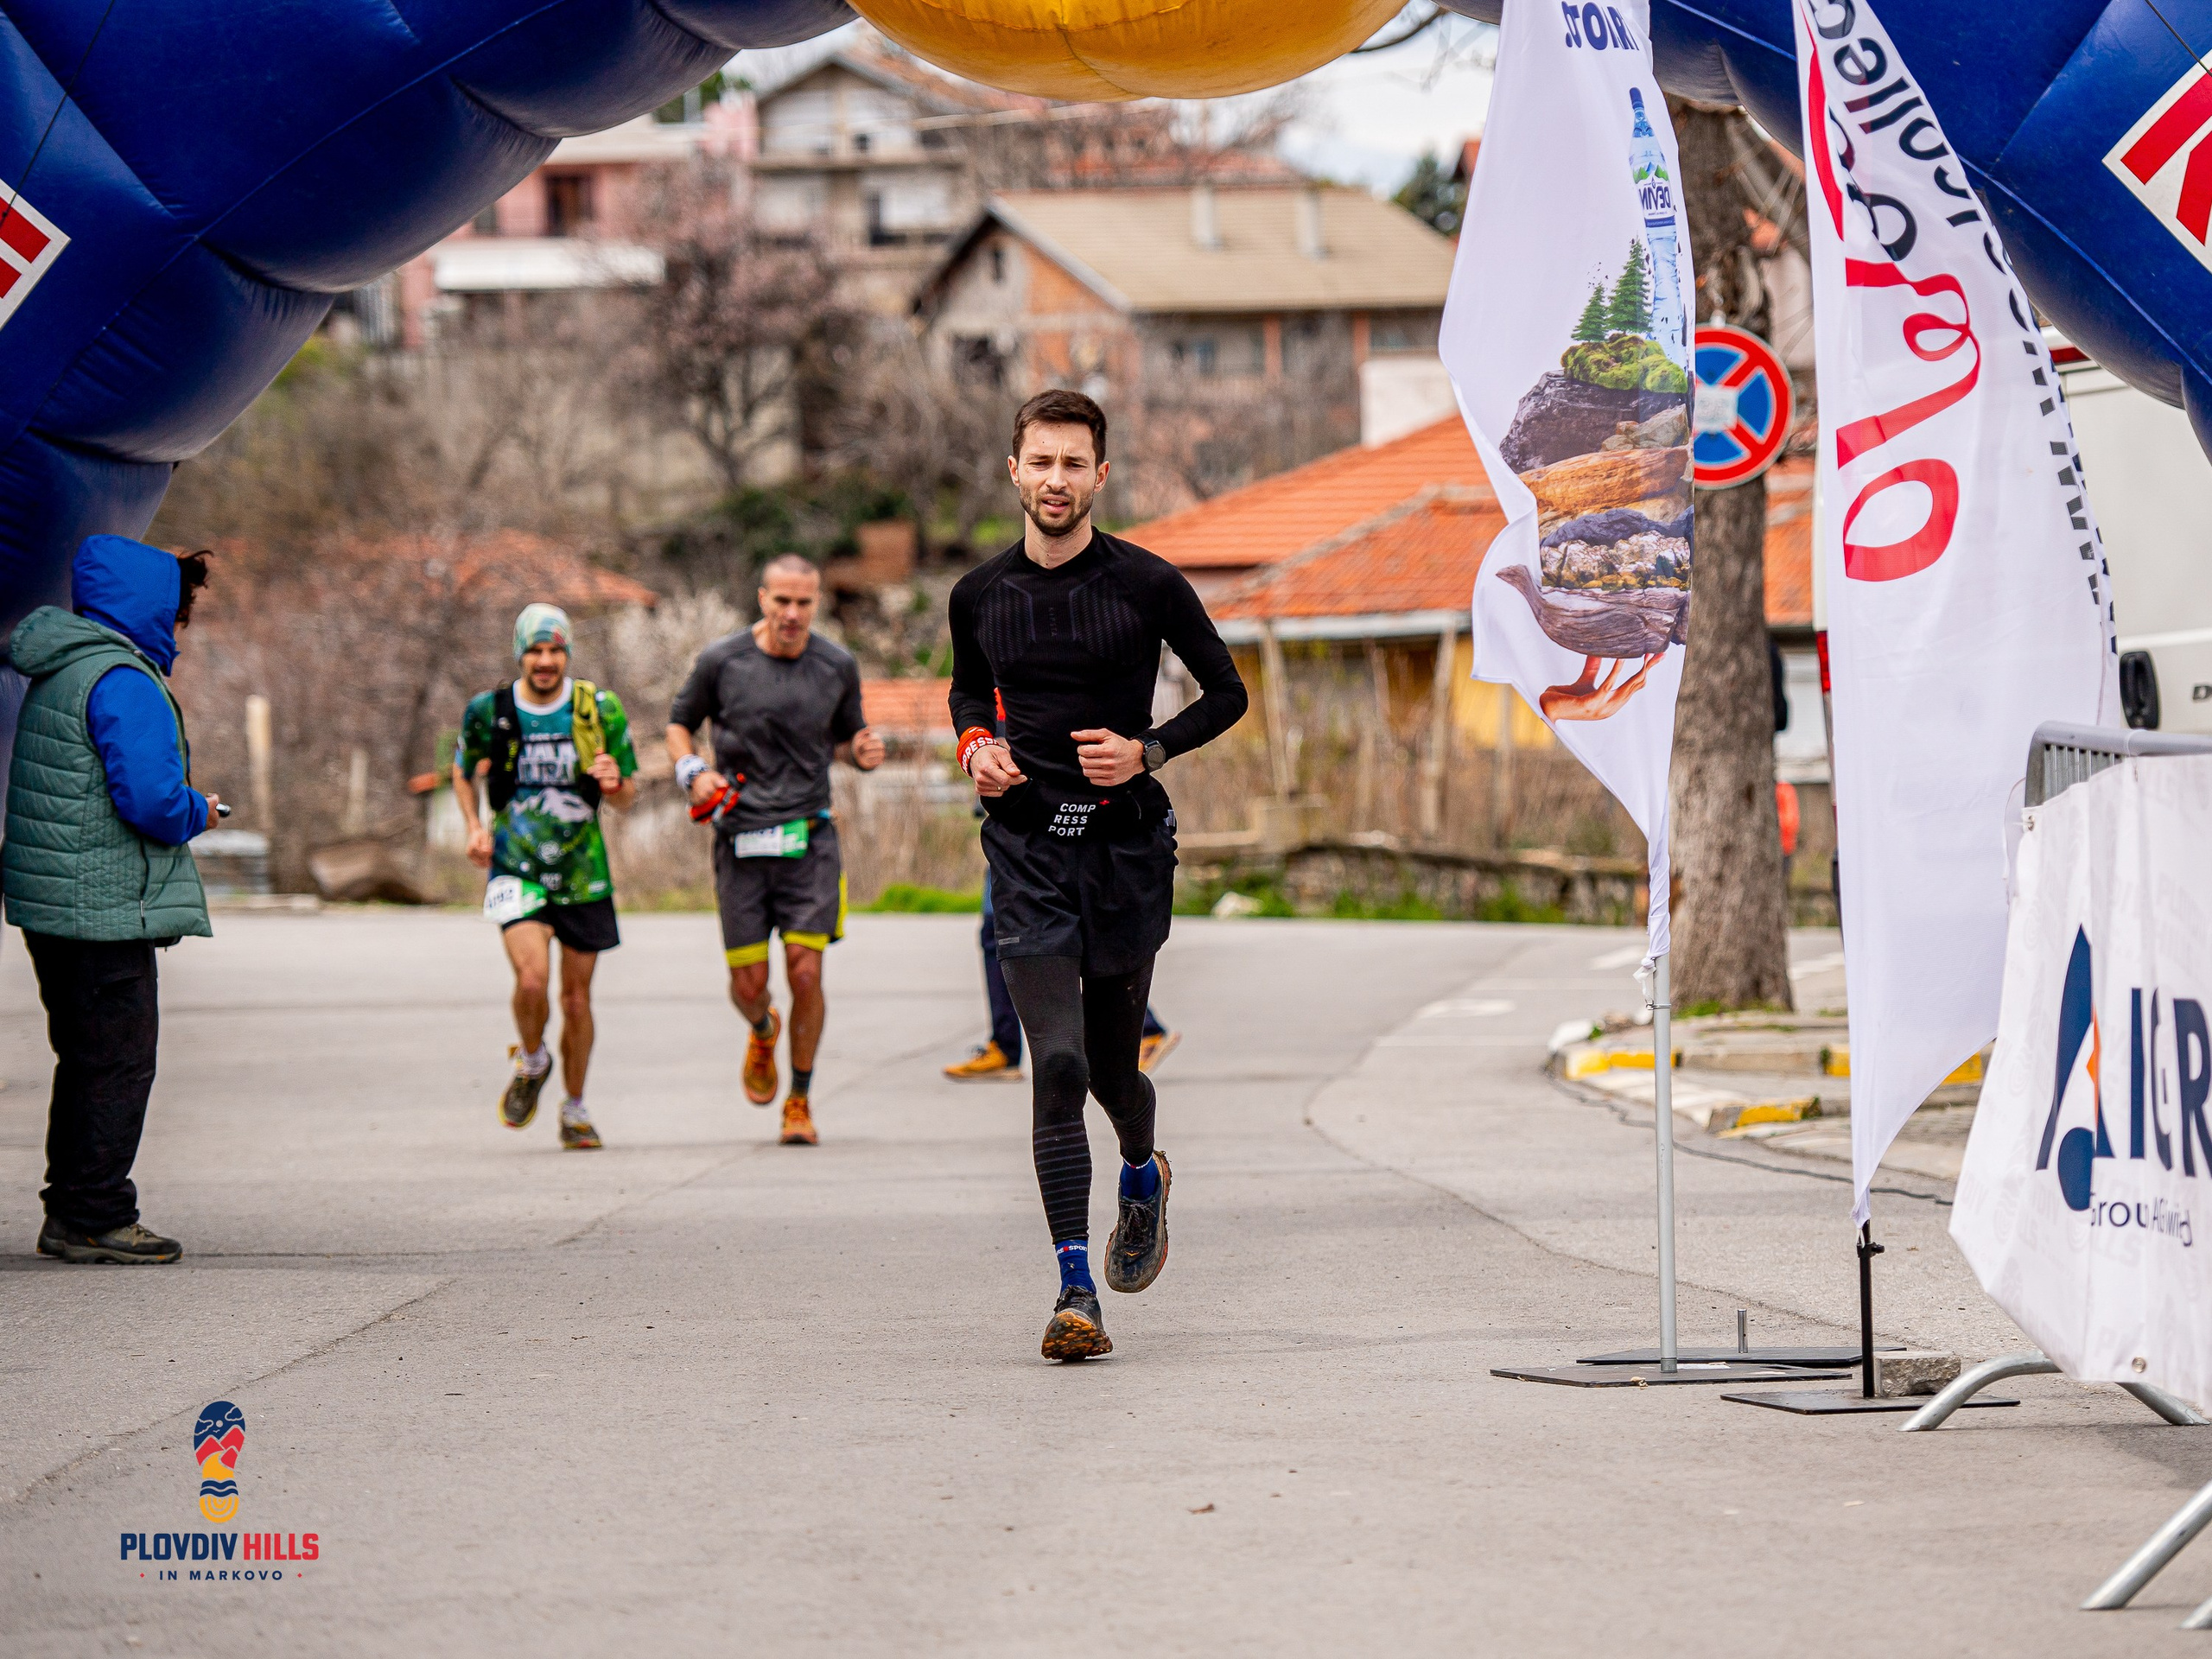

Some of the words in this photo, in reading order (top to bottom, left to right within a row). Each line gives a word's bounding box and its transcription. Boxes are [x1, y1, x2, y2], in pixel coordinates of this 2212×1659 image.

[1059, 803, 1096, 813] COMP
[1053, 814, 1088, 824] RESS
[1047, 825, 1085, 836] PORT
